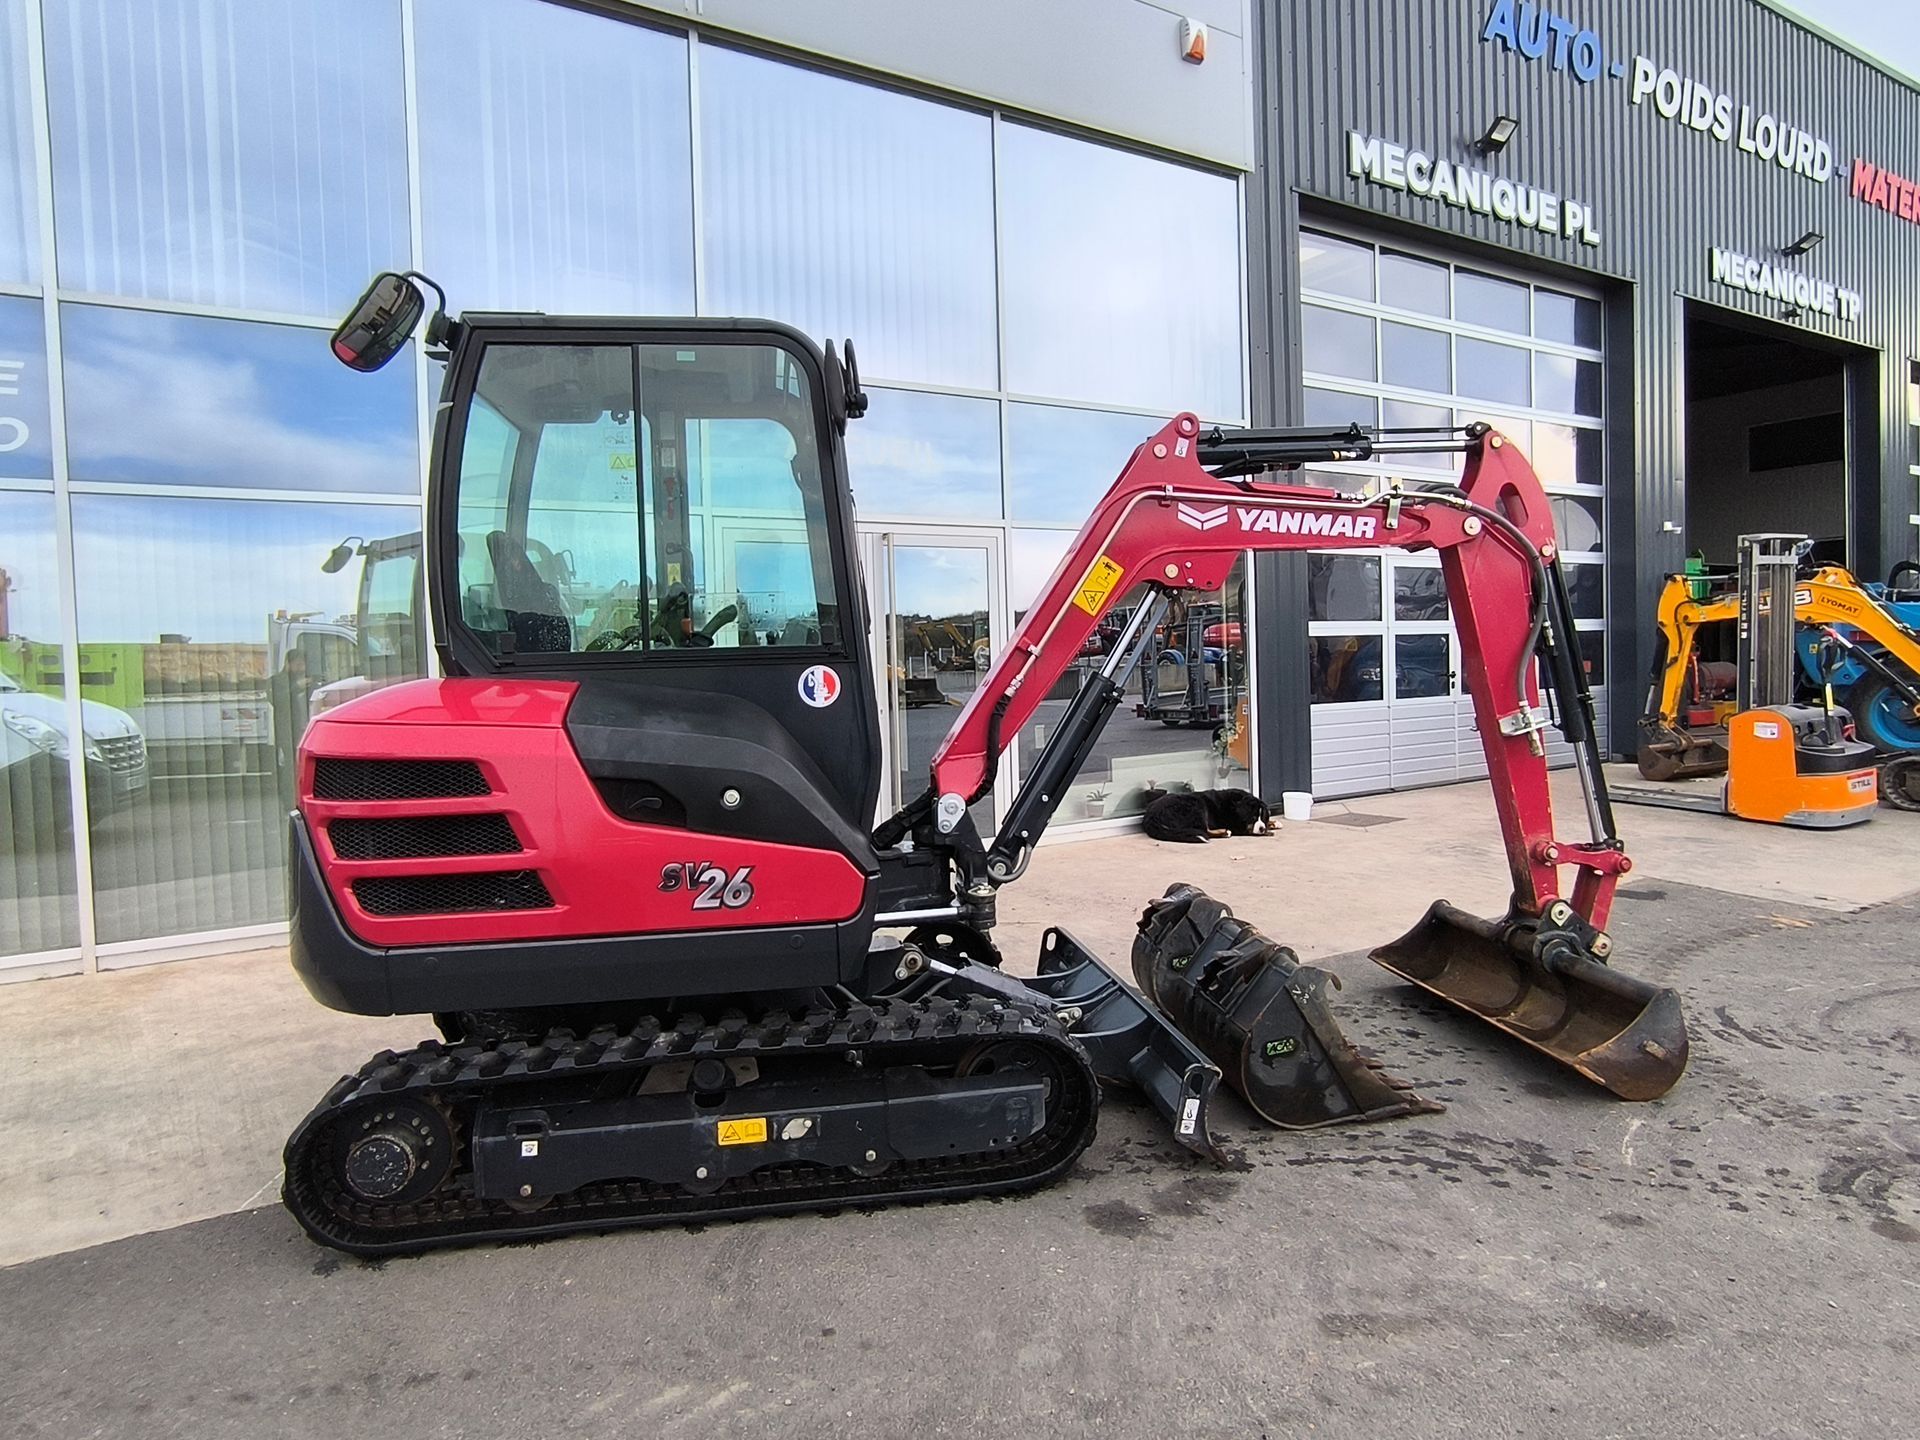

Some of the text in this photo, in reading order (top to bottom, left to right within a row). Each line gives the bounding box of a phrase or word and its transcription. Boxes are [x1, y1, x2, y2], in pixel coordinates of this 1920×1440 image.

[1484, 0, 1601, 81] AUTO
[1632, 55, 1733, 141] POIDS
[1739, 104, 1832, 182] LOURD
[1349, 130, 1600, 246] MECANIQUE PL
[1711, 246, 1861, 322] MECANIQUE TP
[1236, 507, 1377, 539] YANMAR
[1820, 596, 1860, 614] LYOMAT
[657, 860, 756, 911] SV26
